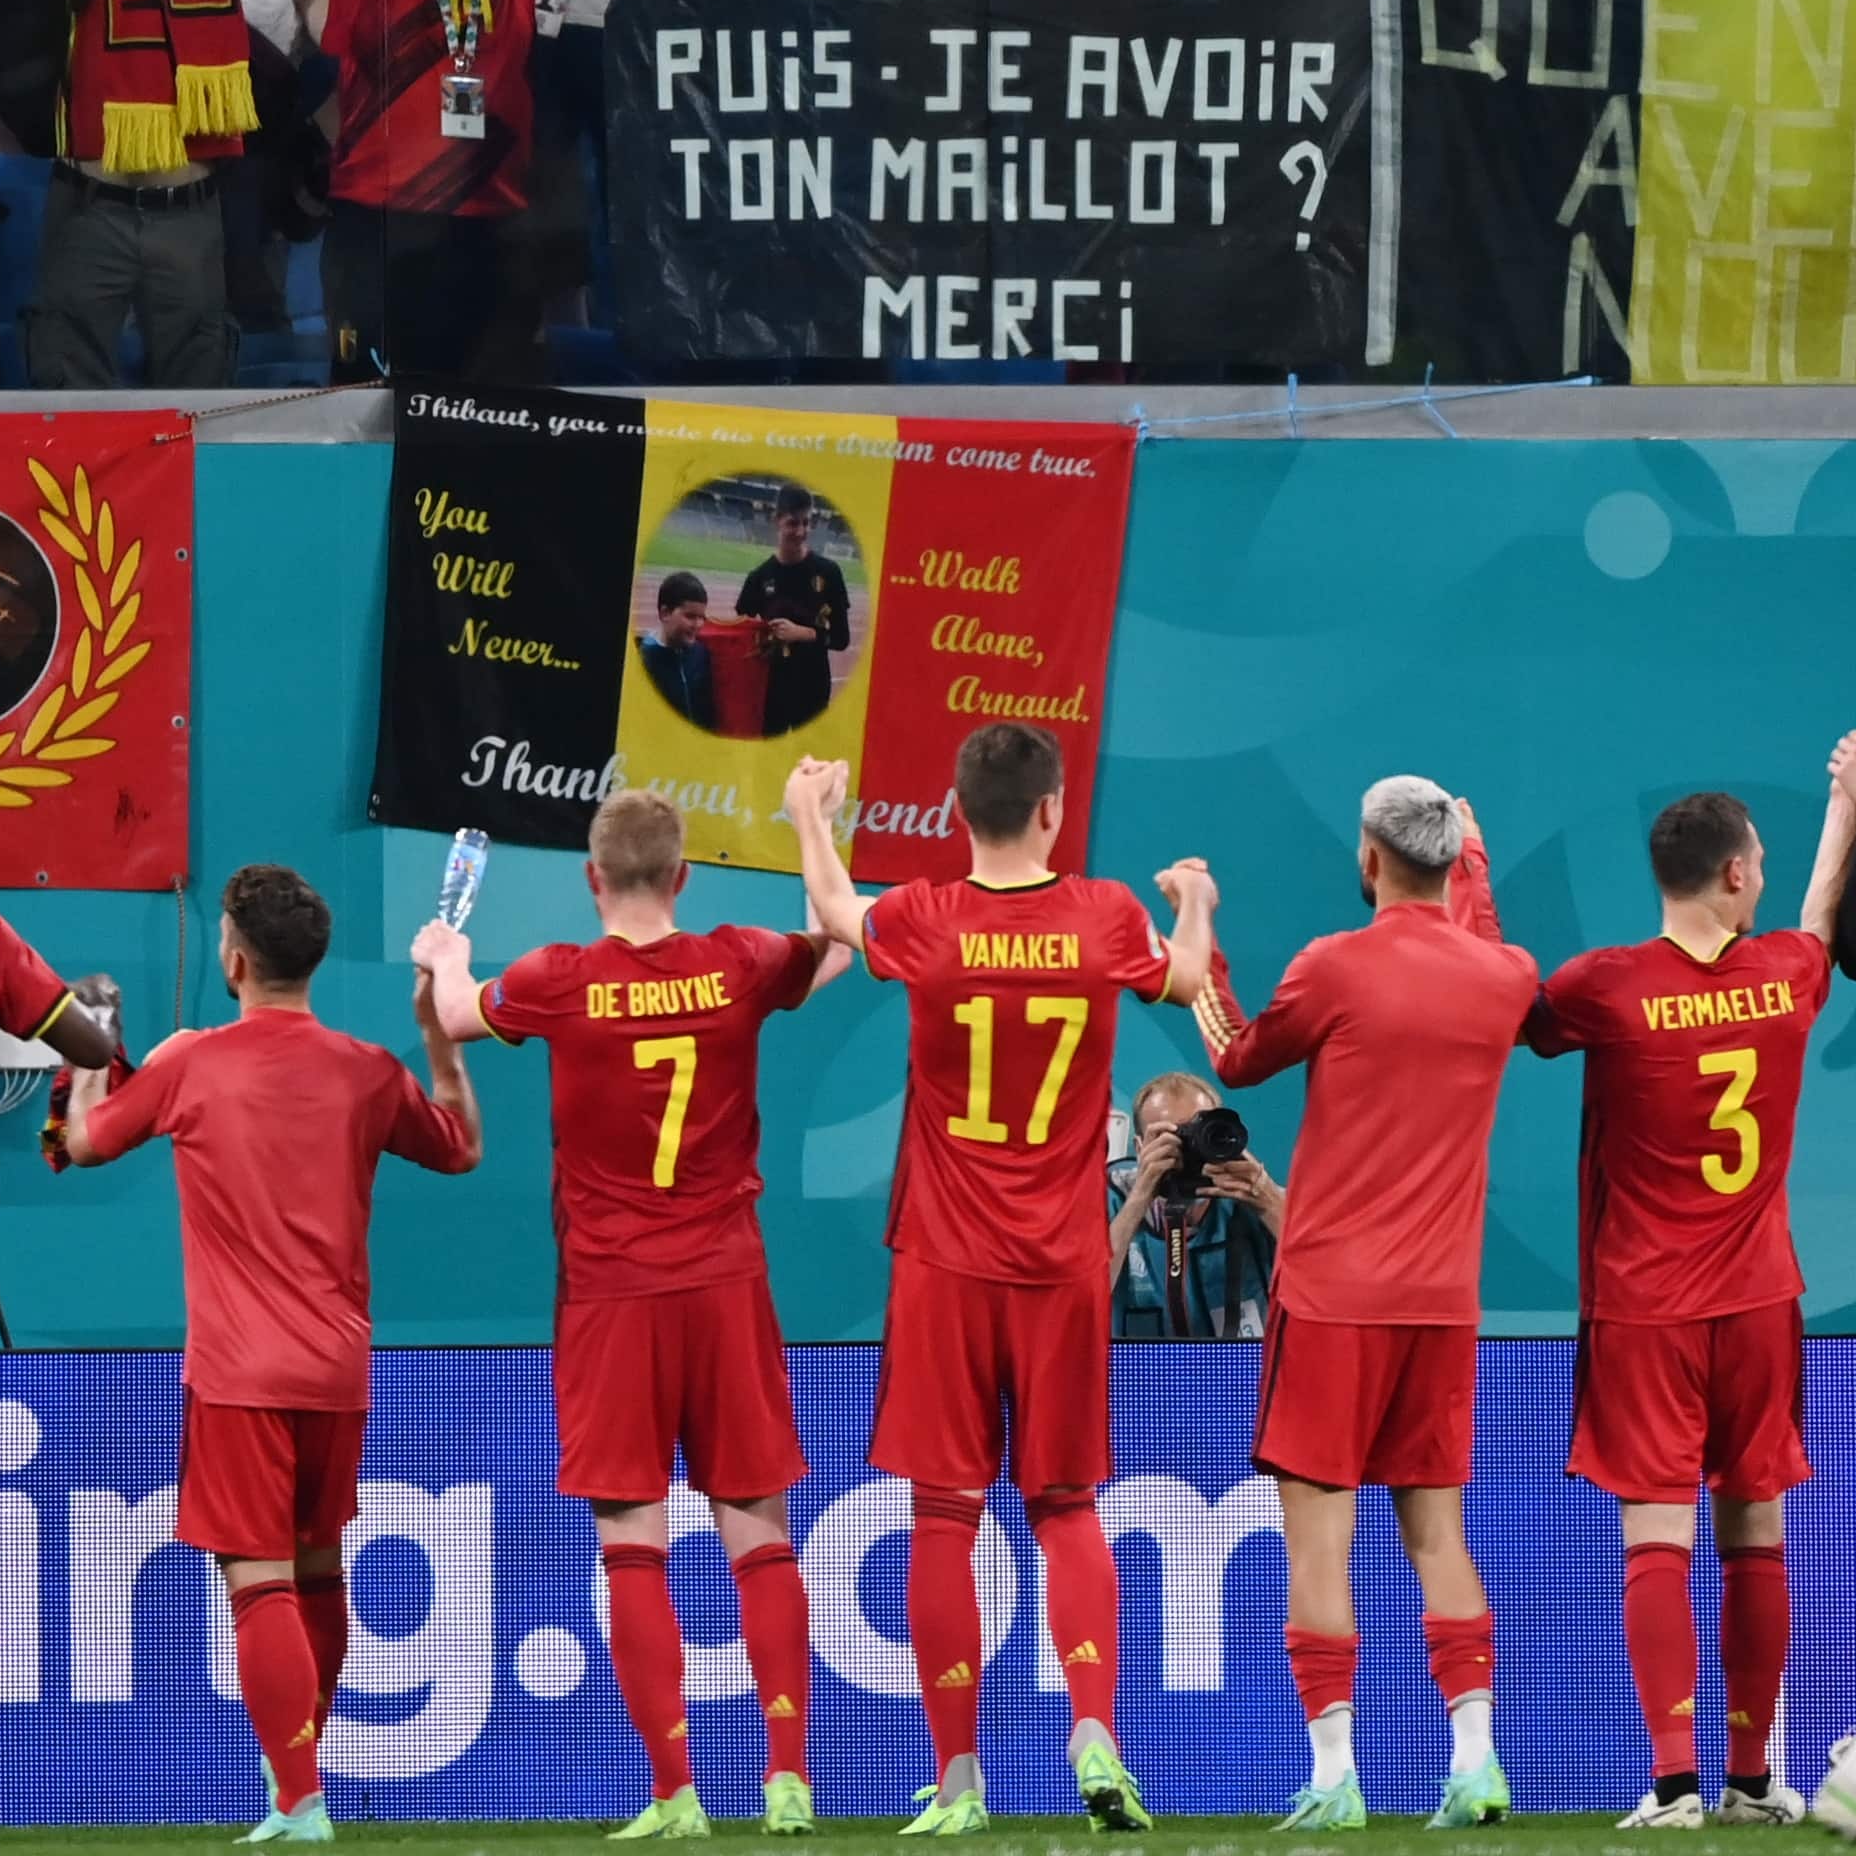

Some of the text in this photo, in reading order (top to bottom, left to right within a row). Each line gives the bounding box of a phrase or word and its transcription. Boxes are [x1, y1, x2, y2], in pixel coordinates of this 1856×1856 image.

[669, 136, 834, 222] TON
[406, 393, 540, 432] Thibaut,
[548, 411, 608, 436] you
[834, 431, 936, 465] dream
[945, 444, 1021, 472] come
[1028, 447, 1097, 479] true.
[413, 486, 492, 536] You
[431, 551, 515, 601] Will
[930, 613, 1046, 669] Alone,
[946, 674, 1091, 724] Arnaud.
[460, 735, 627, 807] Thank
[770, 784, 955, 843] Lgend
[958, 932, 1080, 970] VANAKEN
[586, 971, 733, 1020] DE BRUYNE
[1641, 979, 1795, 1031] VERMAELEN
[946, 996, 1090, 1145] 17
[632, 1034, 698, 1189] 7
[1697, 1047, 1761, 1195] 3
[1167, 1227, 1186, 1278] Canon
